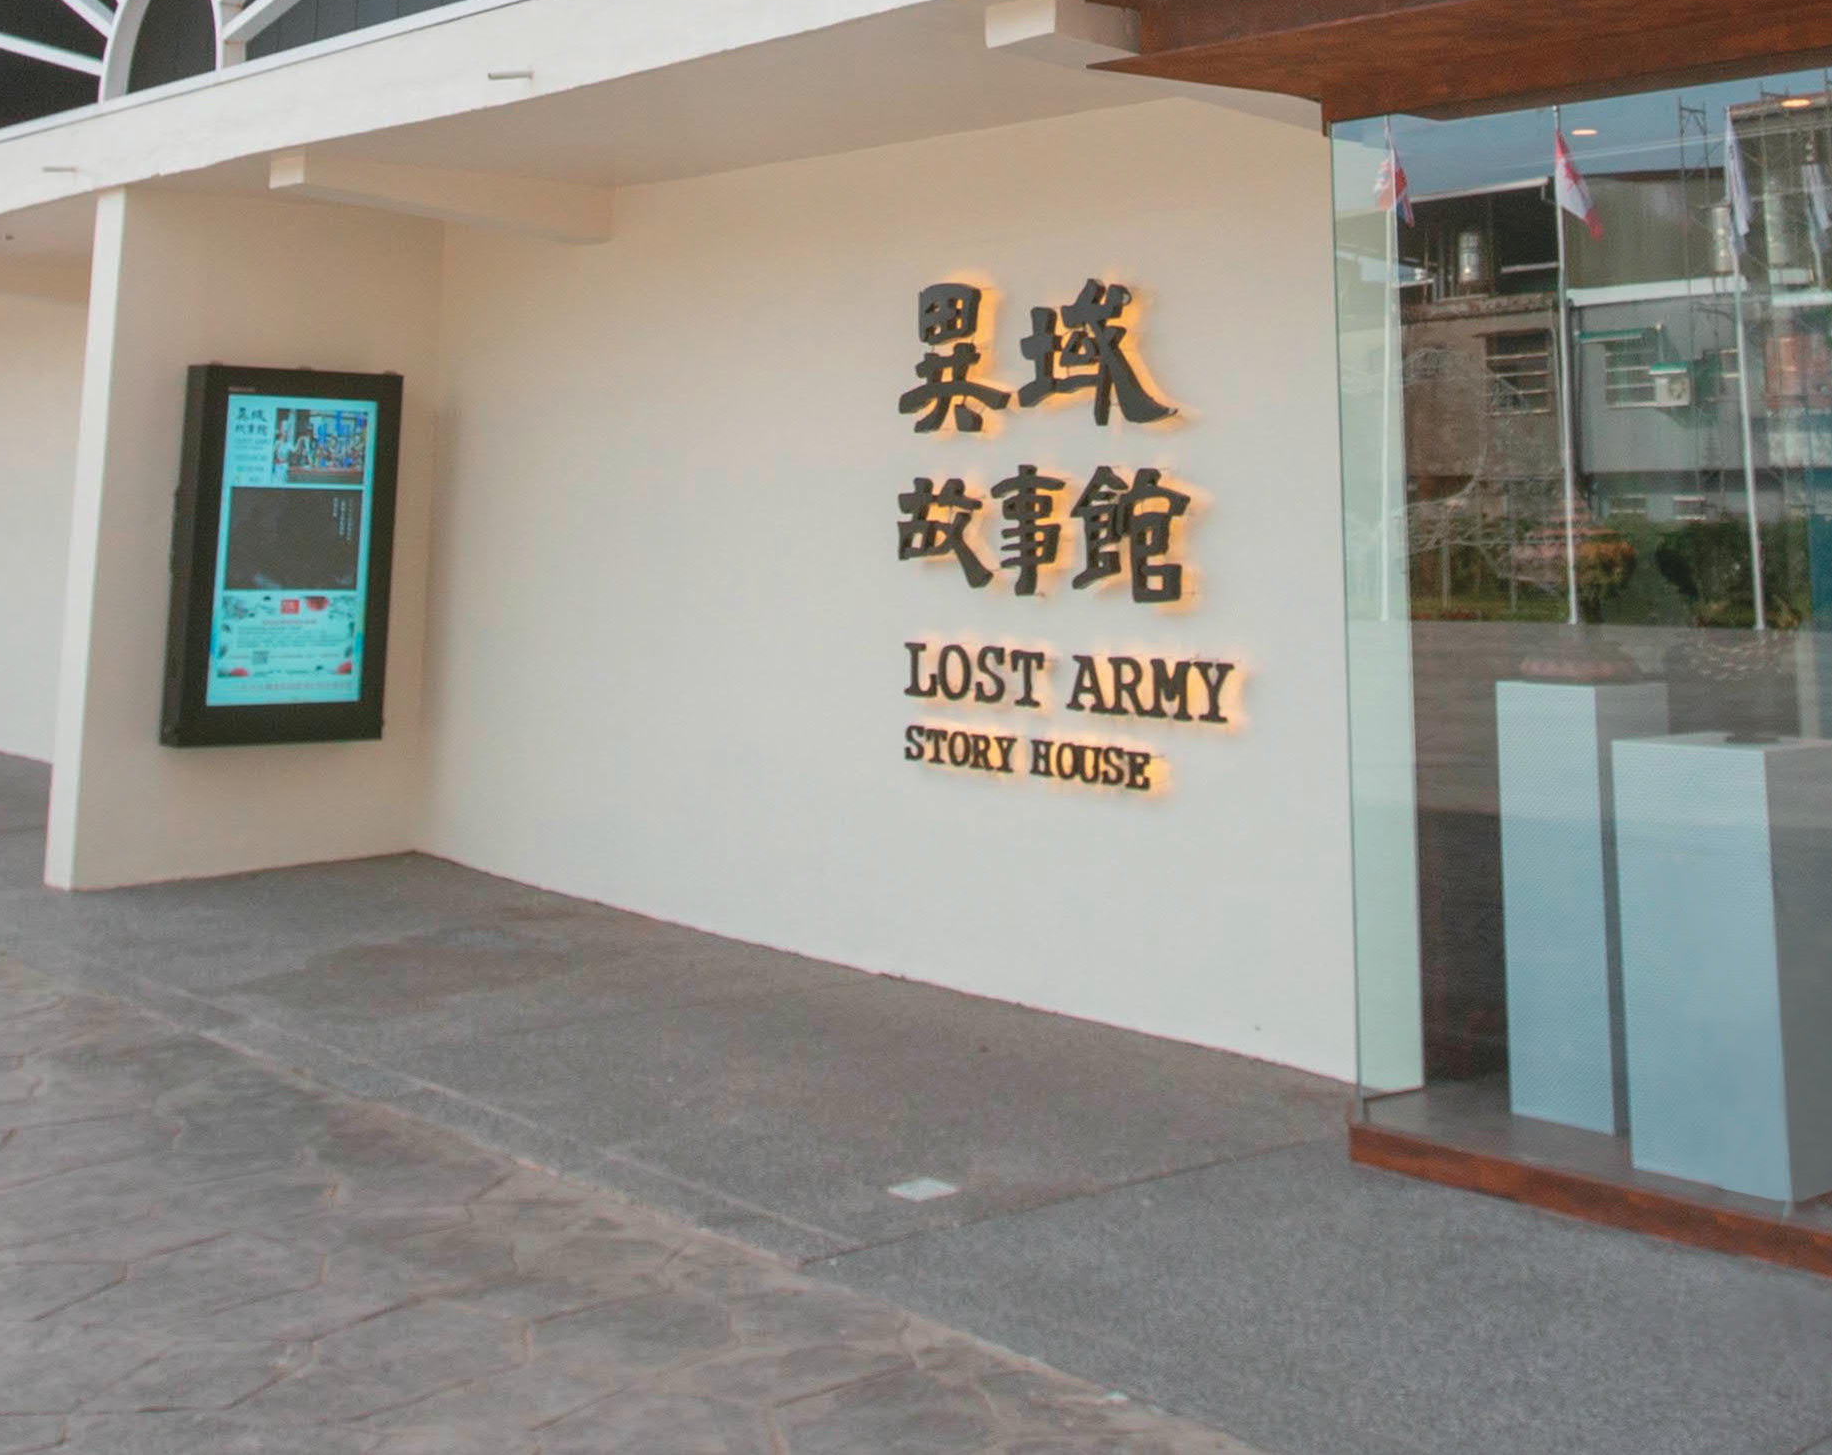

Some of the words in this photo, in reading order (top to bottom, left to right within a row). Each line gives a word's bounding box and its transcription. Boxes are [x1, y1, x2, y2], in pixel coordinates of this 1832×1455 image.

[898, 278, 1180, 433] 異域
[897, 465, 1191, 603] 故事館
[904, 642, 1045, 707] LOST
[1066, 654, 1235, 723] ARMY
[904, 725, 1017, 774] STORY
[1030, 739, 1152, 791] HOUSE
